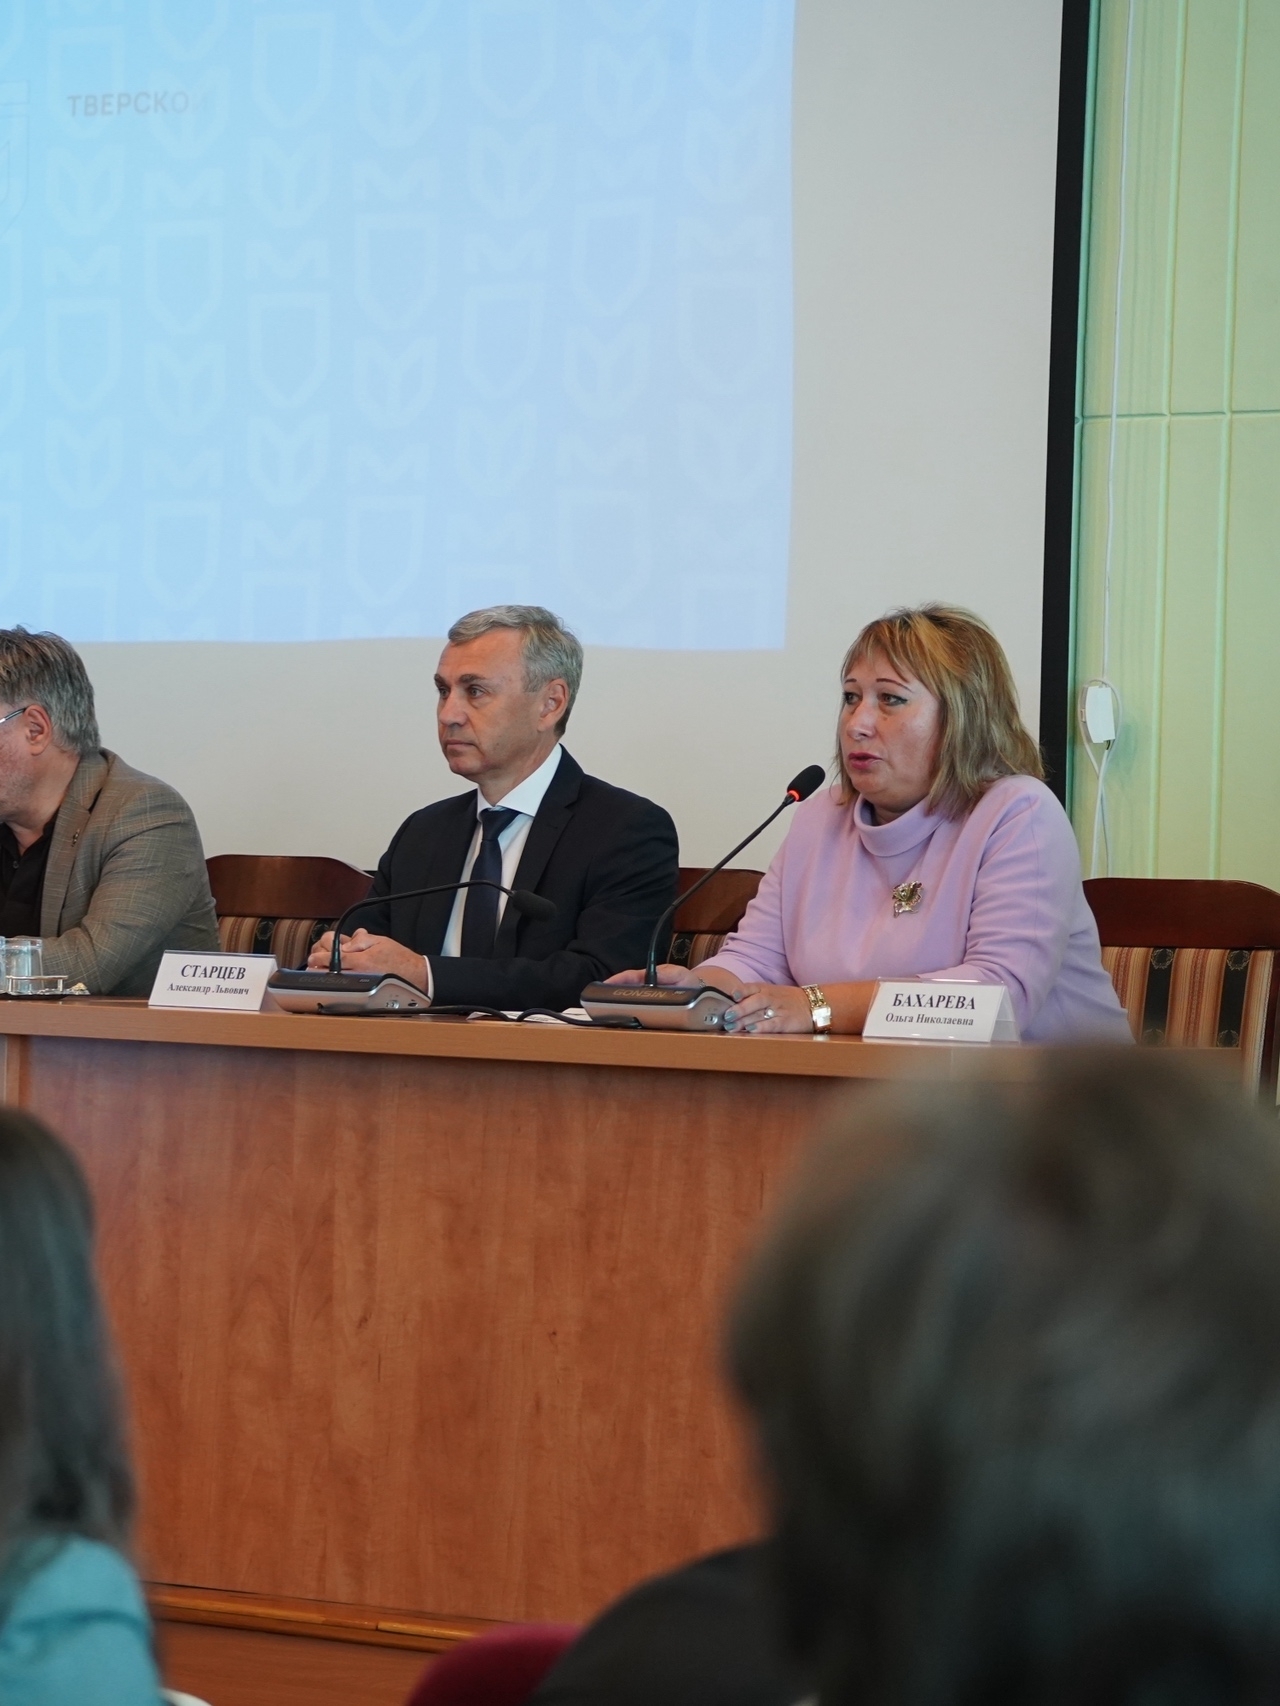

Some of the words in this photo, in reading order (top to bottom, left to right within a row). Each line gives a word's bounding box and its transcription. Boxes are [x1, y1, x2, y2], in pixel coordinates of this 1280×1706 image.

[66, 90, 208, 118] ТВЕРСКО
[181, 964, 246, 981] СТАРЦЕВ
[167, 982, 211, 995] Александр
[212, 984, 250, 995] Львович
[612, 988, 668, 998] GONSIN
[892, 993, 976, 1010] БАХАРЕВА
[885, 1012, 914, 1023] Ольга
[916, 1013, 974, 1026] Николаевна
